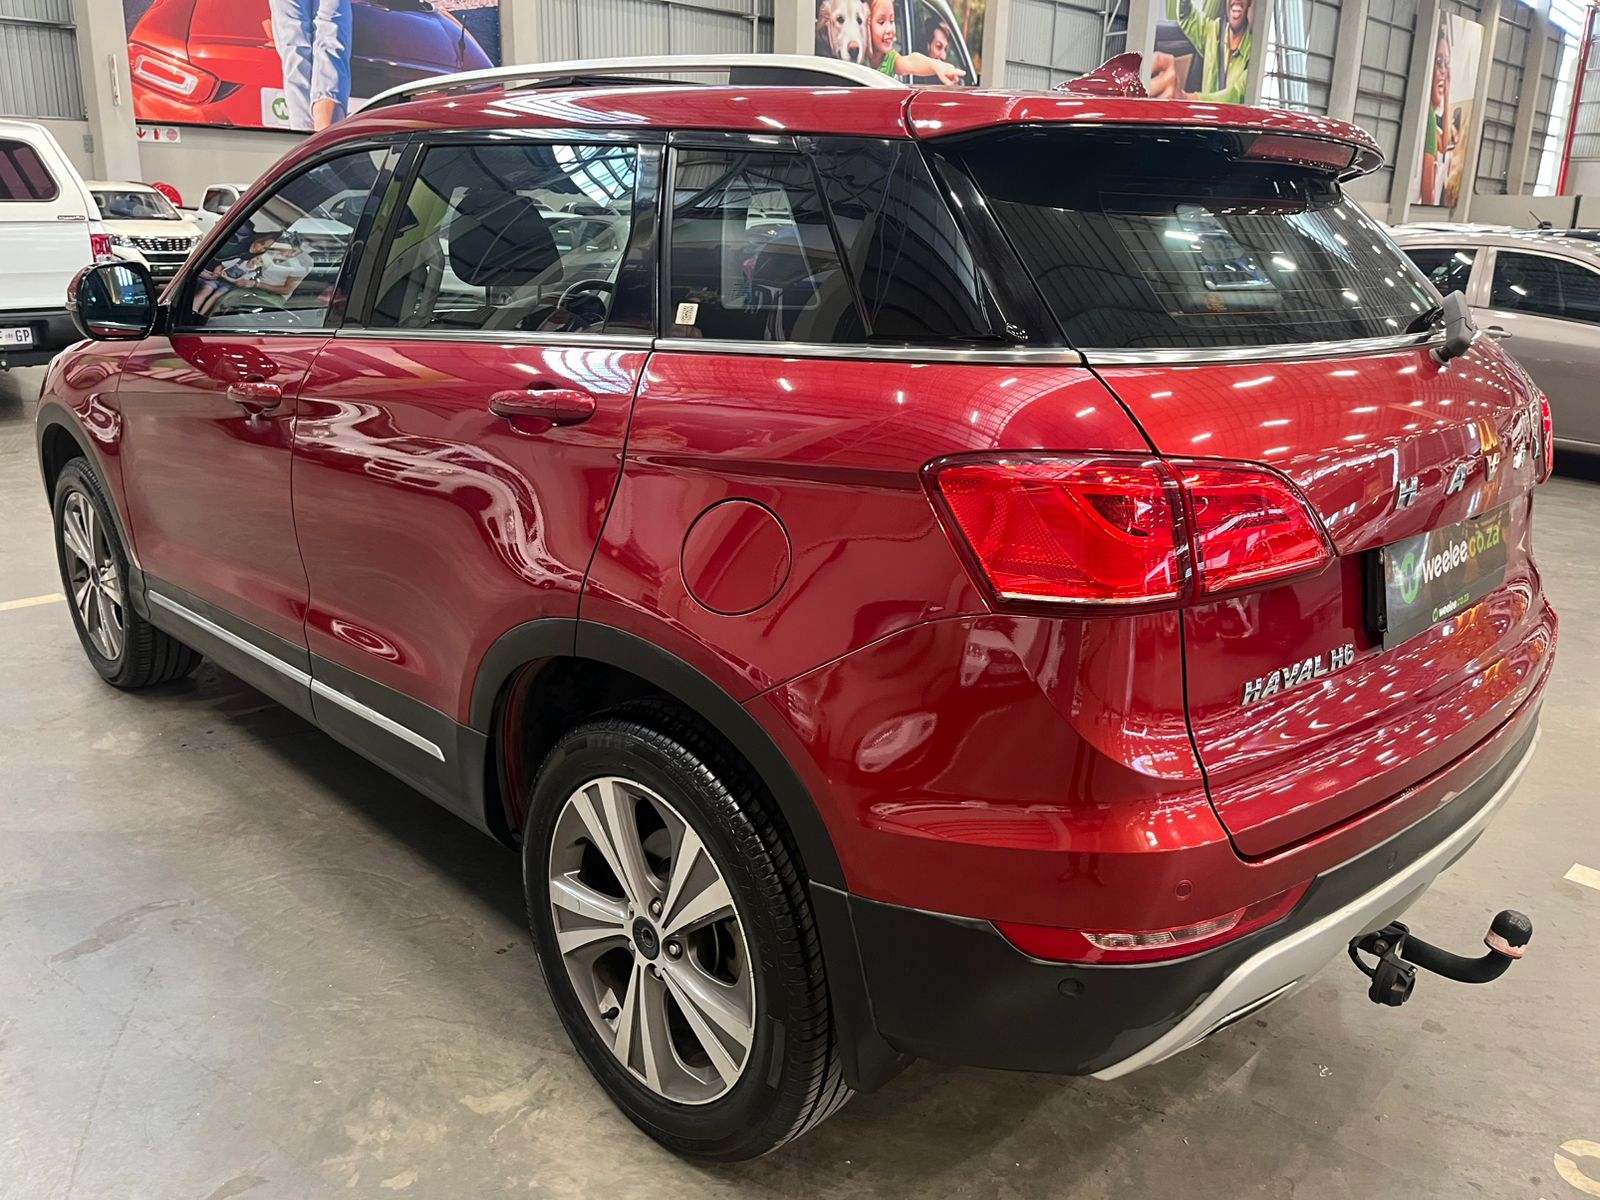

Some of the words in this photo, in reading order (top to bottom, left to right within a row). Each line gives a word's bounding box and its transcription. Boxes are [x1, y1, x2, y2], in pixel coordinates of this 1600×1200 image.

[15, 329, 30, 342] GP
[1241, 655, 1328, 706] HAVAL
[1330, 643, 1355, 672] H6
